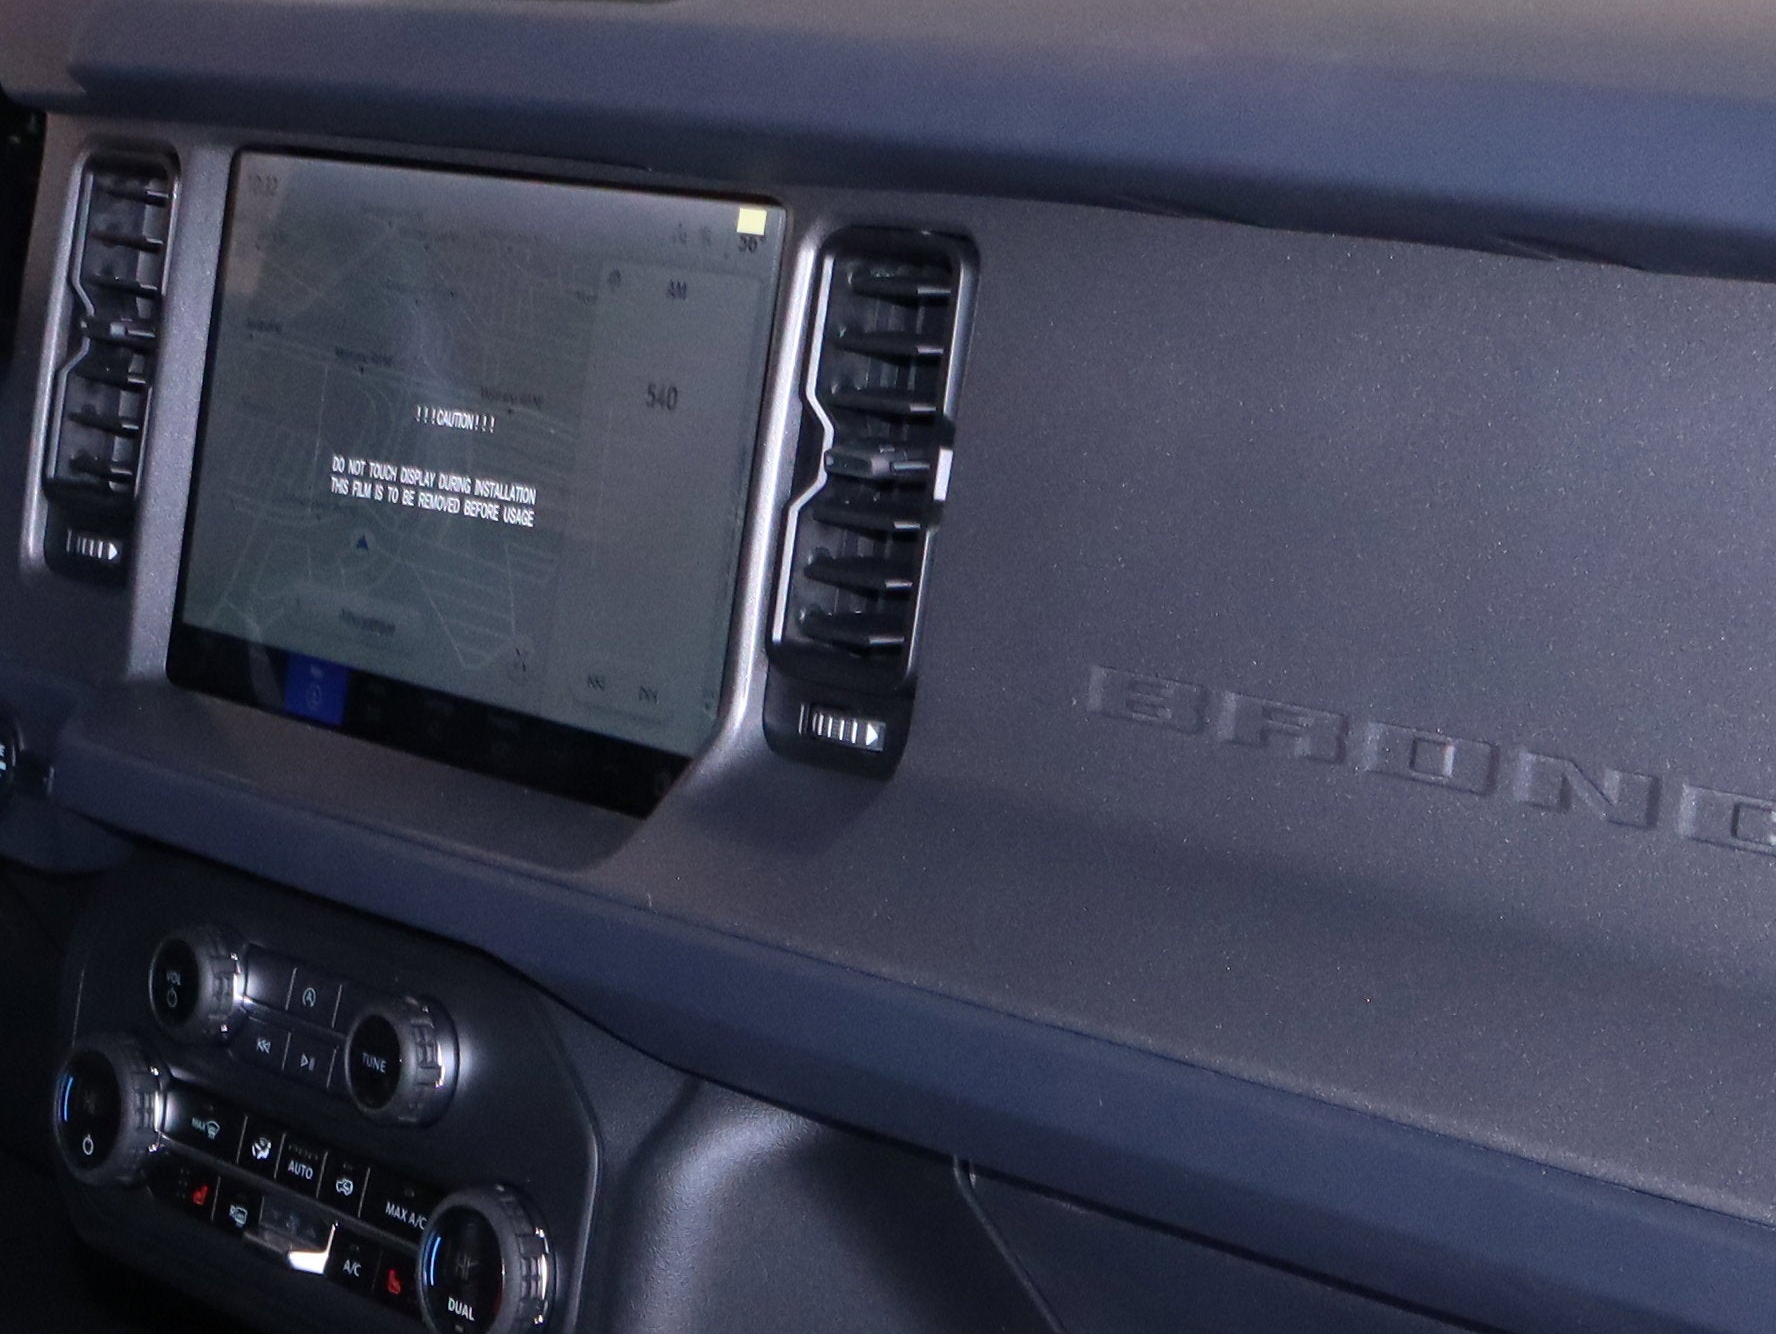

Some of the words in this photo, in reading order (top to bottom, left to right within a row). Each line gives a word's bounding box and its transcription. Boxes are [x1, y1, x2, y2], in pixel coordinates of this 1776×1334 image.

[645, 382, 679, 412] 540
[332, 455, 345, 472] DO
[348, 459, 365, 476] NOT
[369, 462, 397, 482] TOUCH
[400, 467, 436, 487] DISPLAY
[438, 473, 472, 494] DURING
[474, 478, 536, 505] INSTALLATION
[331, 476, 349, 495] THIS
[352, 482, 371, 499] FILM
[374, 485, 383, 501] IS
[387, 487, 399, 503] TO
[402, 490, 416, 507] BE
[418, 493, 460, 513] REMOVED
[463, 500, 500, 521] BEFORE
[503, 506, 535, 528] USAGE
[166, 970, 182, 986] VOL
[361, 1051, 387, 1074] TUNE
[288, 1160, 313, 1180] AUTO
[385, 1201, 407, 1224] MAX
[408, 1212, 428, 1230] A/C
[343, 1259, 362, 1277] A/C
[447, 1297, 475, 1321] DUAL
